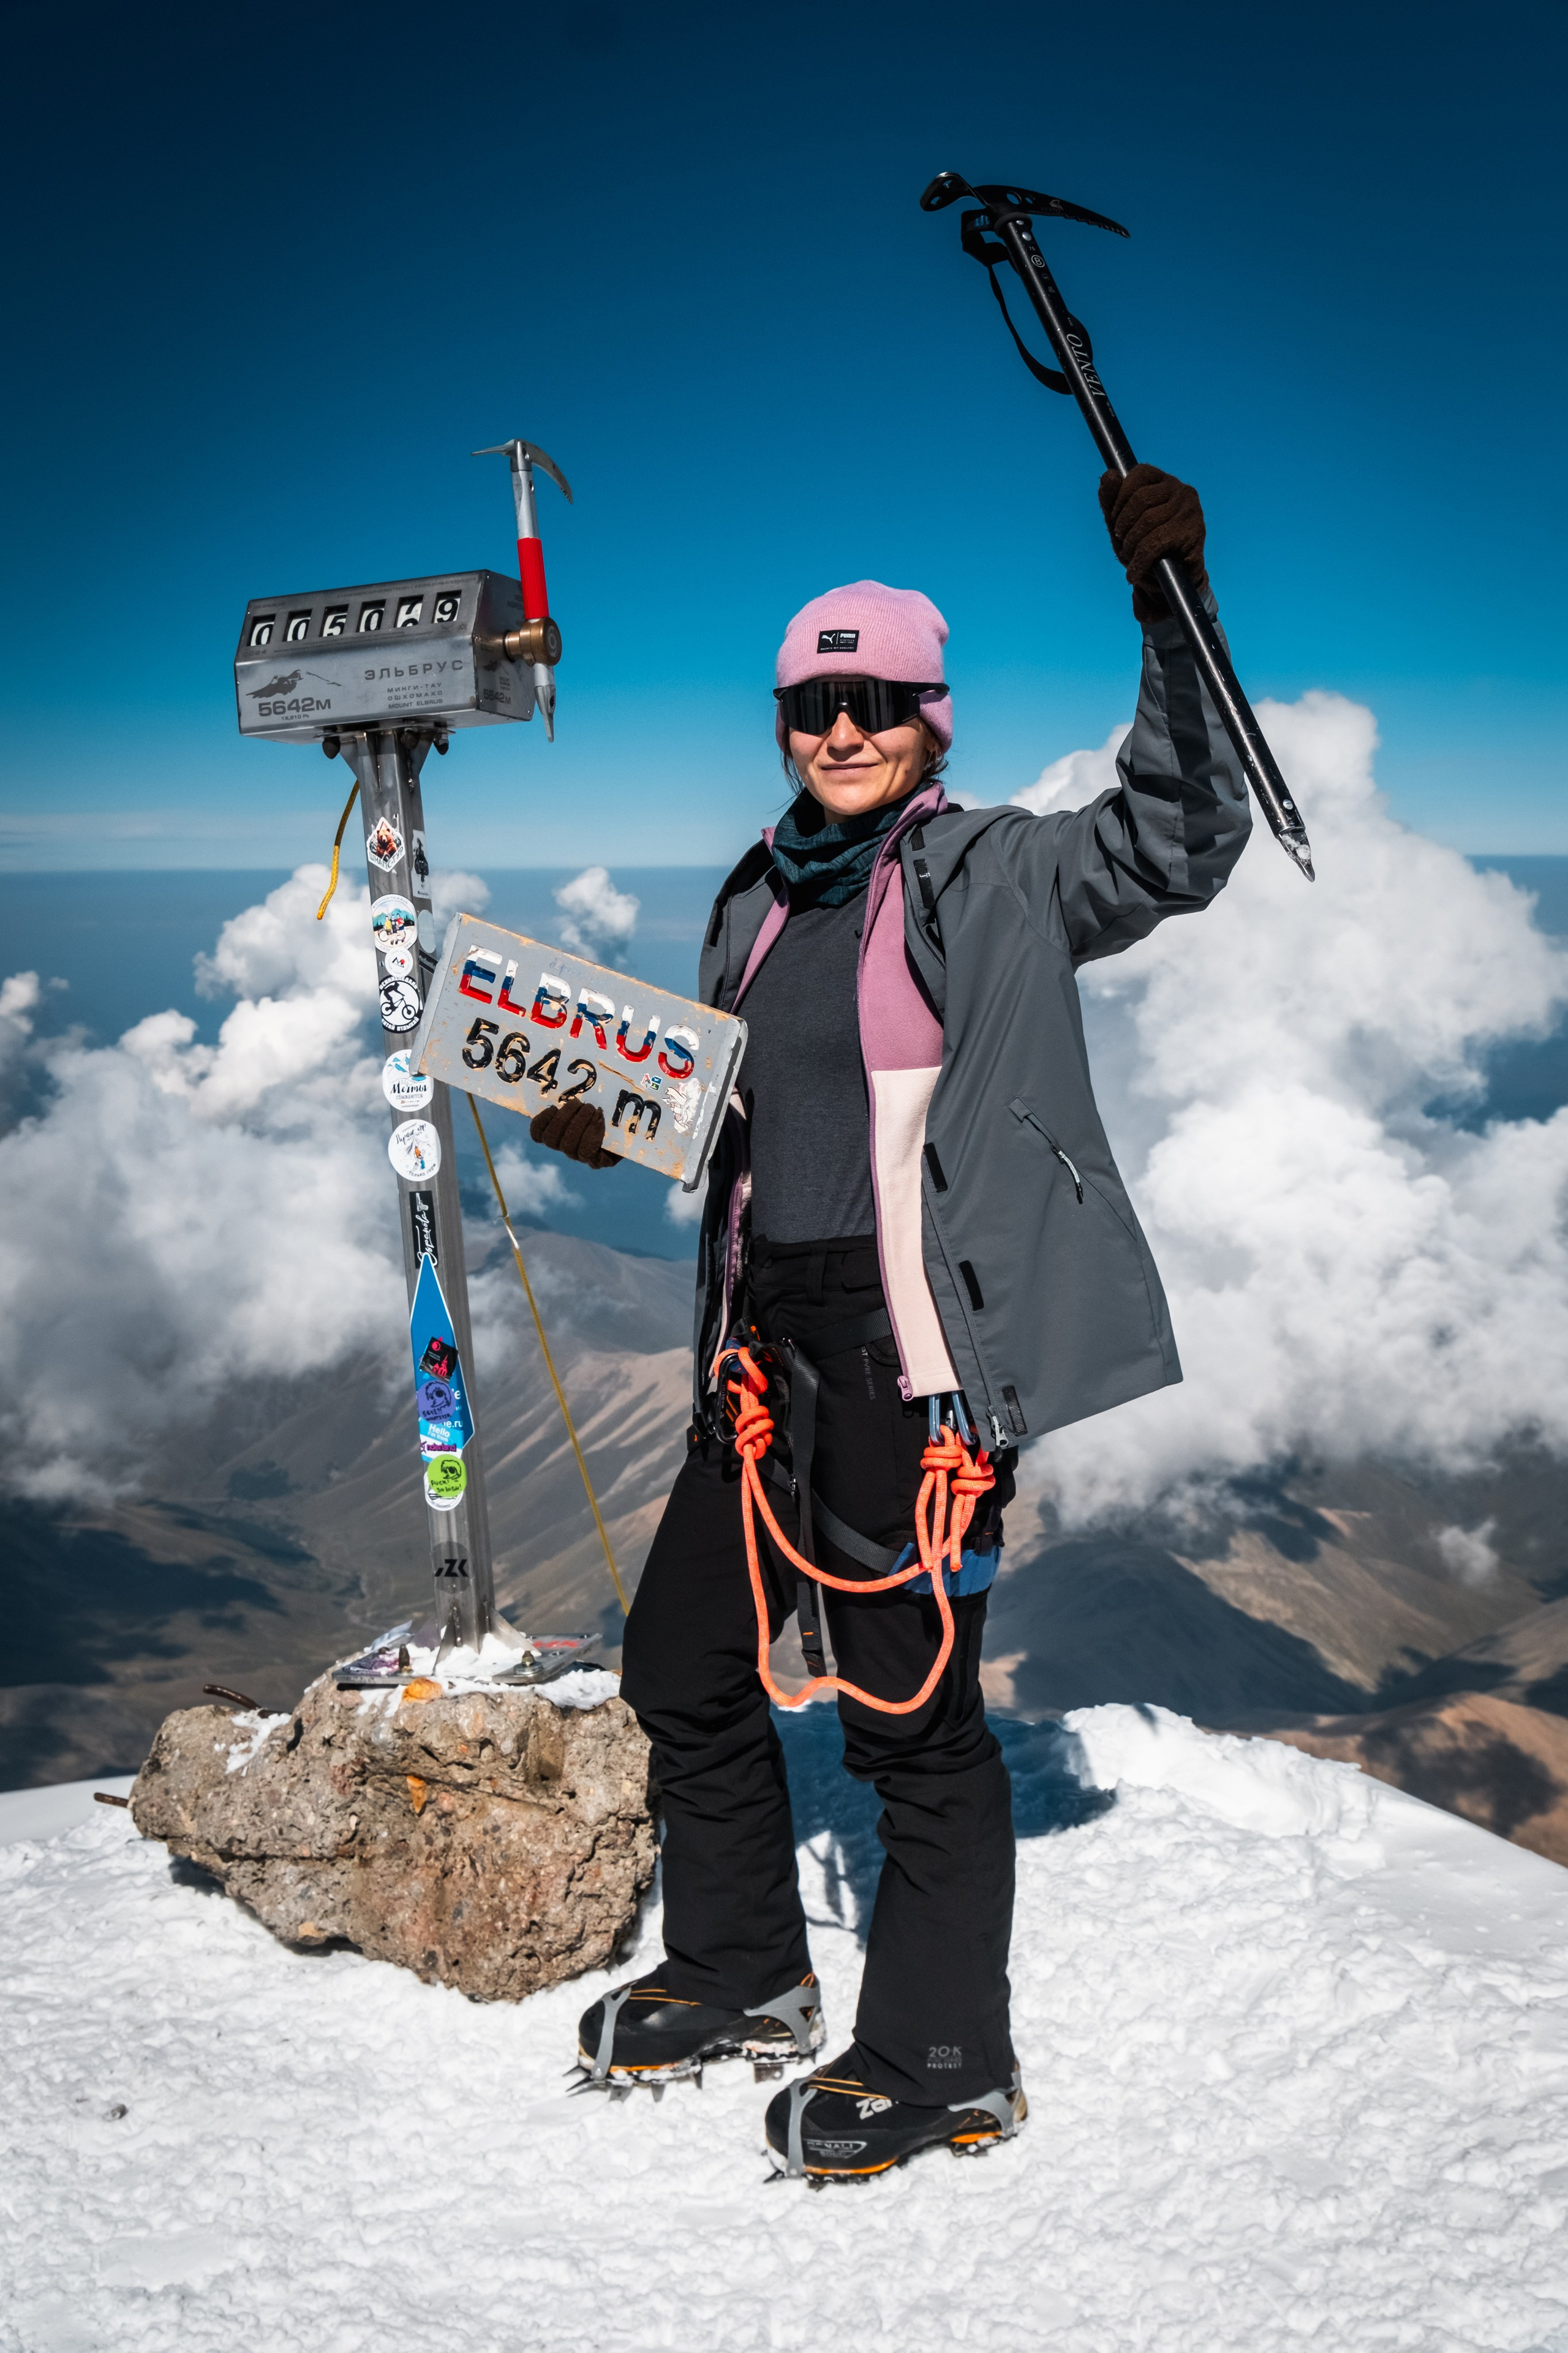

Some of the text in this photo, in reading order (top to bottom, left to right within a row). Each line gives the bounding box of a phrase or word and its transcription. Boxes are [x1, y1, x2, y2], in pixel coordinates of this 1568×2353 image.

[1066, 333, 1106, 397] VENTO
[364, 660, 463, 681] ЭЛЬБРУС
[387, 682, 442, 693] МИНГИ-ТАУ
[458, 943, 700, 1080] ELBRUS
[462, 1018, 662, 1141] 5642 m
[866, 1377, 876, 1400] SERIES
[429, 1423, 451, 1438] Hello
